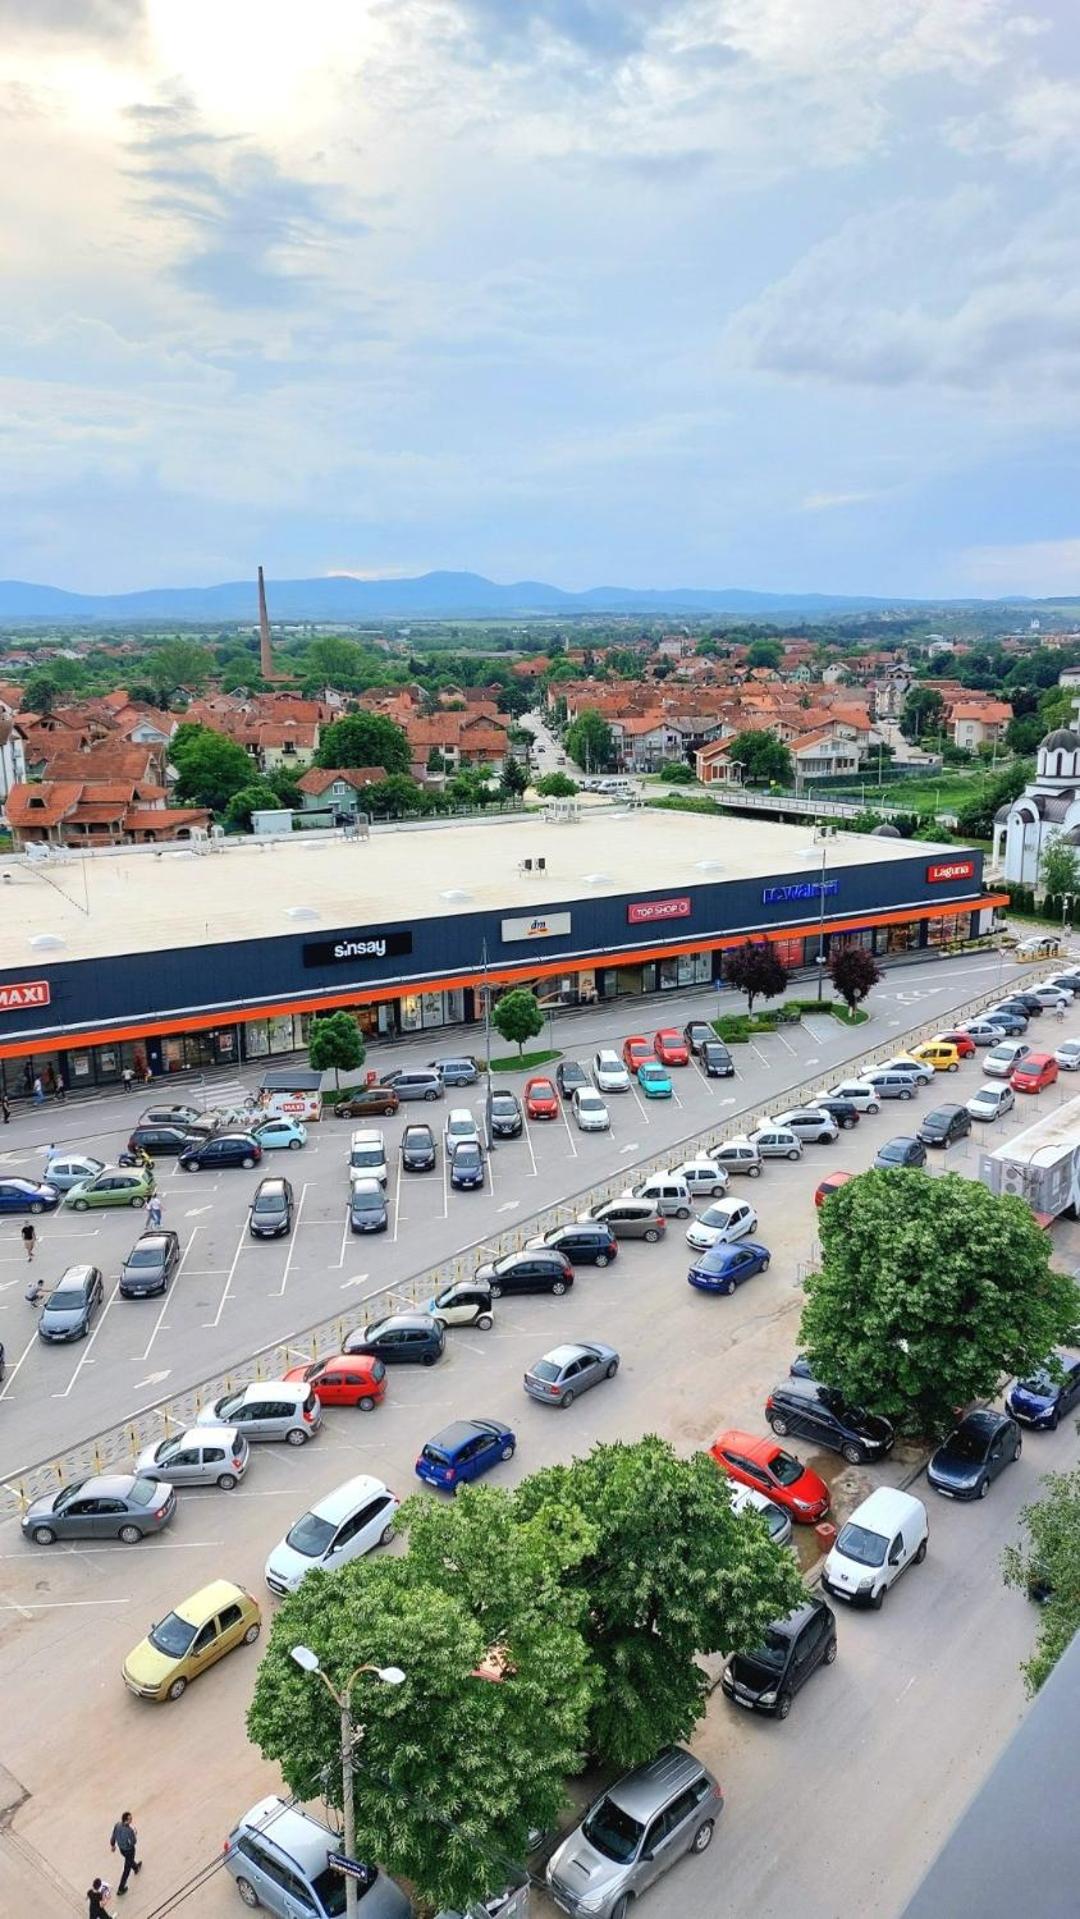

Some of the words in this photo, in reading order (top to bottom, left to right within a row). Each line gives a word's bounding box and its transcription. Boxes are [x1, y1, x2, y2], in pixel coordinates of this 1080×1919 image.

[934, 865, 969, 878] Laguna
[636, 907, 653, 916] TOP
[530, 919, 546, 930] dm
[334, 939, 386, 958] sinsay
